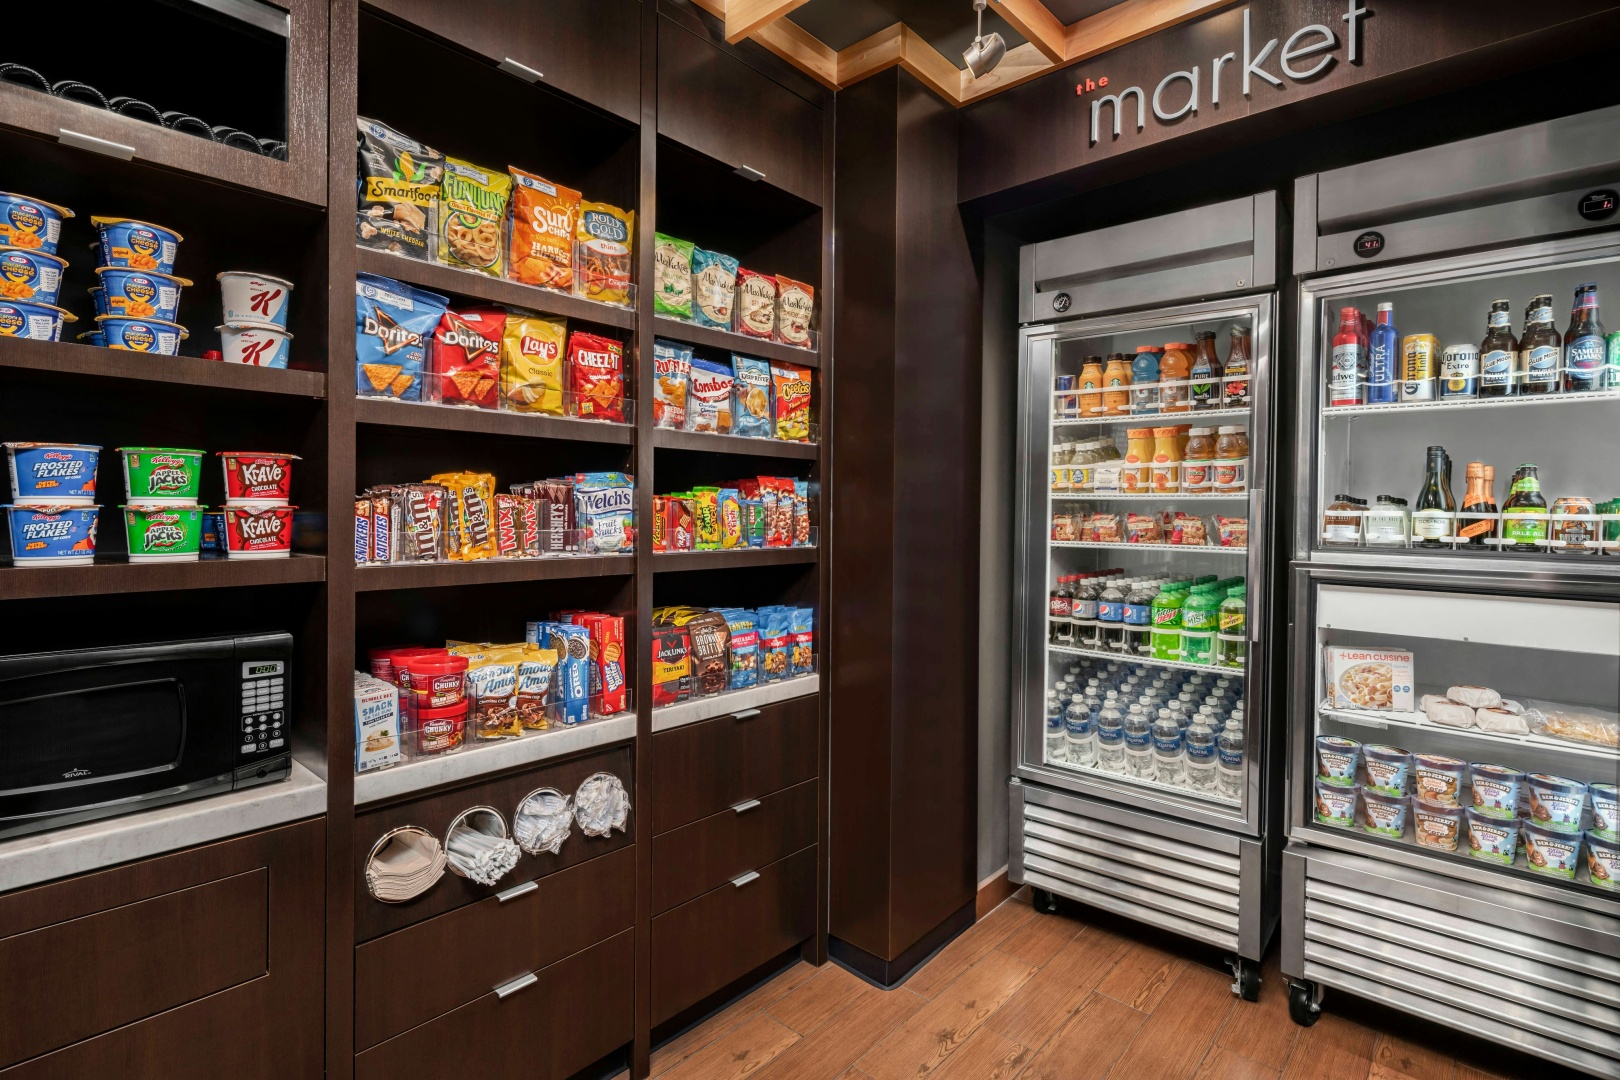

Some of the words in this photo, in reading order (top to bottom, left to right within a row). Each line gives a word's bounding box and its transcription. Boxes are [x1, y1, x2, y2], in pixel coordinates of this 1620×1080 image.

[1091, 0, 1367, 142] market
[1076, 75, 1109, 96] the
[372, 180, 440, 203] Smartfood
[532, 205, 574, 233] Sun
[592, 212, 619, 227] ROLD
[380, 226, 400, 238] WHITE
[401, 234, 425, 248] CHEDDAR
[589, 222, 624, 240] GOLD
[600, 242, 618, 251] thins
[743, 283, 759, 297] Miss
[250, 288, 282, 316] K
[782, 296, 797, 308] Miss
[445, 331, 499, 353] Doritos
[523, 336, 556, 359] Lay's
[241, 338, 275, 366] K
[1442, 351, 1479, 366] Corona
[1528, 355, 1543, 366] BLUE
[1543, 350, 1559, 361] MOON
[1571, 346, 1604, 356] SAMUEL
[1573, 353, 1602, 362] ADAMS
[1375, 344, 1386, 382] ULTRA
[1483, 359, 1496, 370] BLUE
[1496, 354, 1512, 365] MOON
[528, 367, 553, 377] Classic
[1404, 351, 1418, 395] Corona
[693, 376, 735, 393] Combos
[782, 380, 810, 402] Cheetos
[44, 451, 73, 460] Kellogg's
[151, 455, 185, 465] Kellogg's
[33, 460, 83, 472] FROSTED
[36, 467, 80, 478] FLAKES
[155, 469, 181, 477] APPLE
[148, 475, 187, 494] JACKS
[251, 484, 278, 492] CHOCOLATE
[581, 490, 631, 510] Welch's
[32, 513, 61, 521] Kellogg's
[145, 512, 180, 521] Kellogg's
[521, 500, 538, 548] TWIX
[598, 519, 617, 529] Fruit
[702, 506, 712, 533] SOUR
[22, 520, 73, 533] FROSTED
[25, 527, 68, 540] FLAKES
[499, 508, 517, 555] TWIX
[550, 503, 564, 550] HERSHEY'S
[594, 526, 622, 539] Snacks
[652, 511, 661, 546] Reese's
[144, 531, 183, 551] JACKS
[249, 536, 277, 544] CHOCOLATE
[355, 517, 369, 562] SNICKERS
[376, 515, 388, 560] SATISFIES
[1187, 613, 1206, 626] MIST
[657, 649, 672, 659] JACK
[1347, 652, 1372, 660] Lean
[1373, 653, 1410, 662] cuisine
[609, 661, 623, 686] Butter
[663, 664, 685, 673] TERIYAKI
[434, 681, 460, 690] CHUNKY
[477, 675, 516, 698] Amos
[572, 662, 583, 698] OREO
[604, 665, 615, 692] Nutter
[362, 694, 383, 703] BUMBLE
[362, 700, 393, 716] SNACK
[424, 724, 452, 733] CHUNKY
